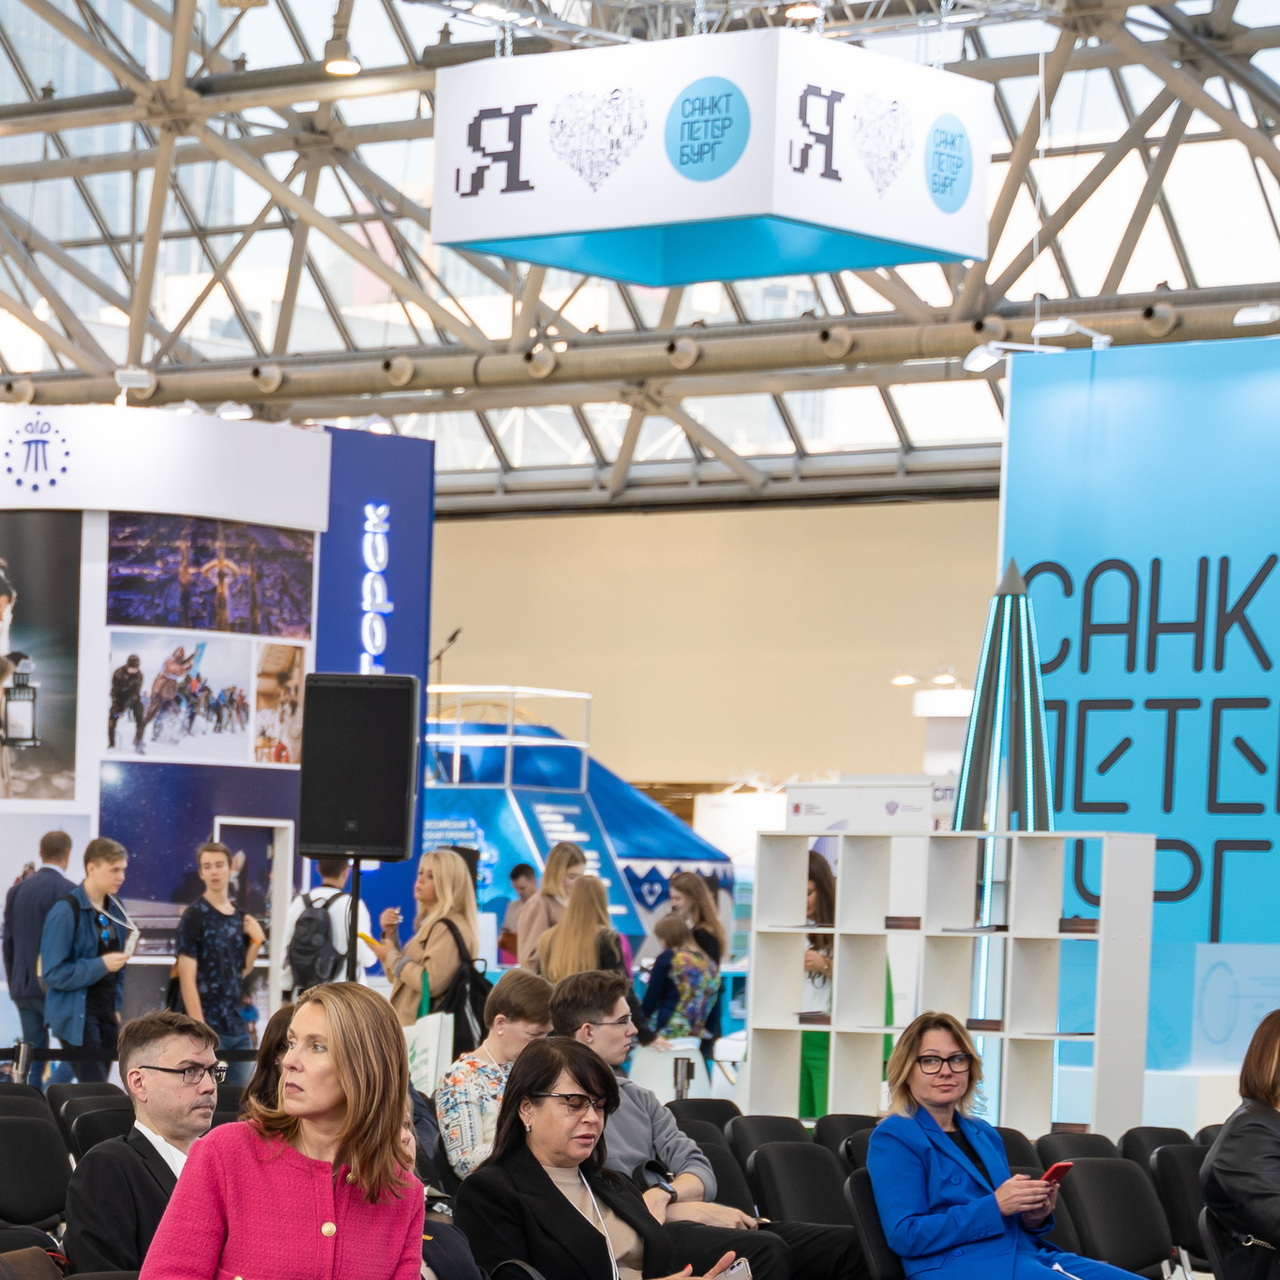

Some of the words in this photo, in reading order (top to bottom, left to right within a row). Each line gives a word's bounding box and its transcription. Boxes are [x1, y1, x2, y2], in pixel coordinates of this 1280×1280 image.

[680, 117, 734, 142] ПЕТЕР
[681, 93, 732, 118] САНКТ
[789, 84, 845, 181] Я
[455, 103, 538, 197] Я
[679, 140, 722, 165] БУРГ
[1022, 554, 1280, 674] САНК
